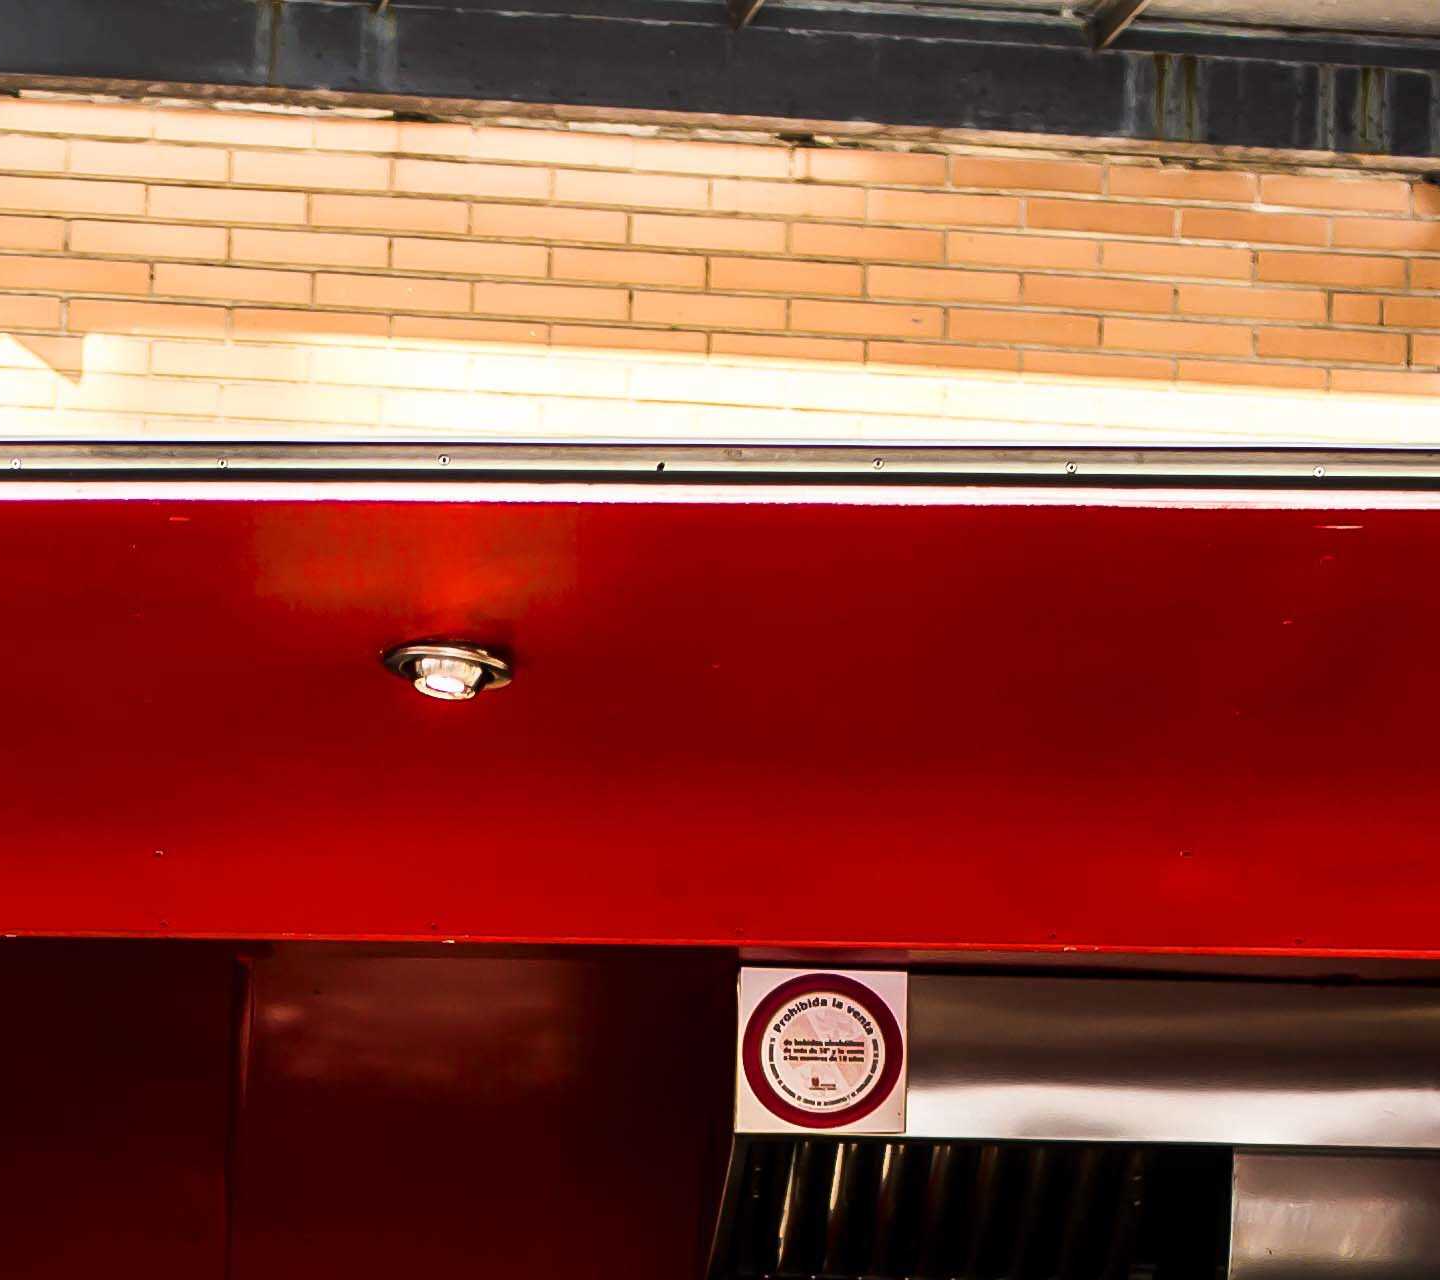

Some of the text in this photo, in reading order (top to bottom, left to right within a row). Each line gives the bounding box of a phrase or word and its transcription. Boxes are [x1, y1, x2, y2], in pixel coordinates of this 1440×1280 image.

[773, 997, 874, 1035] Prohibida la venta
